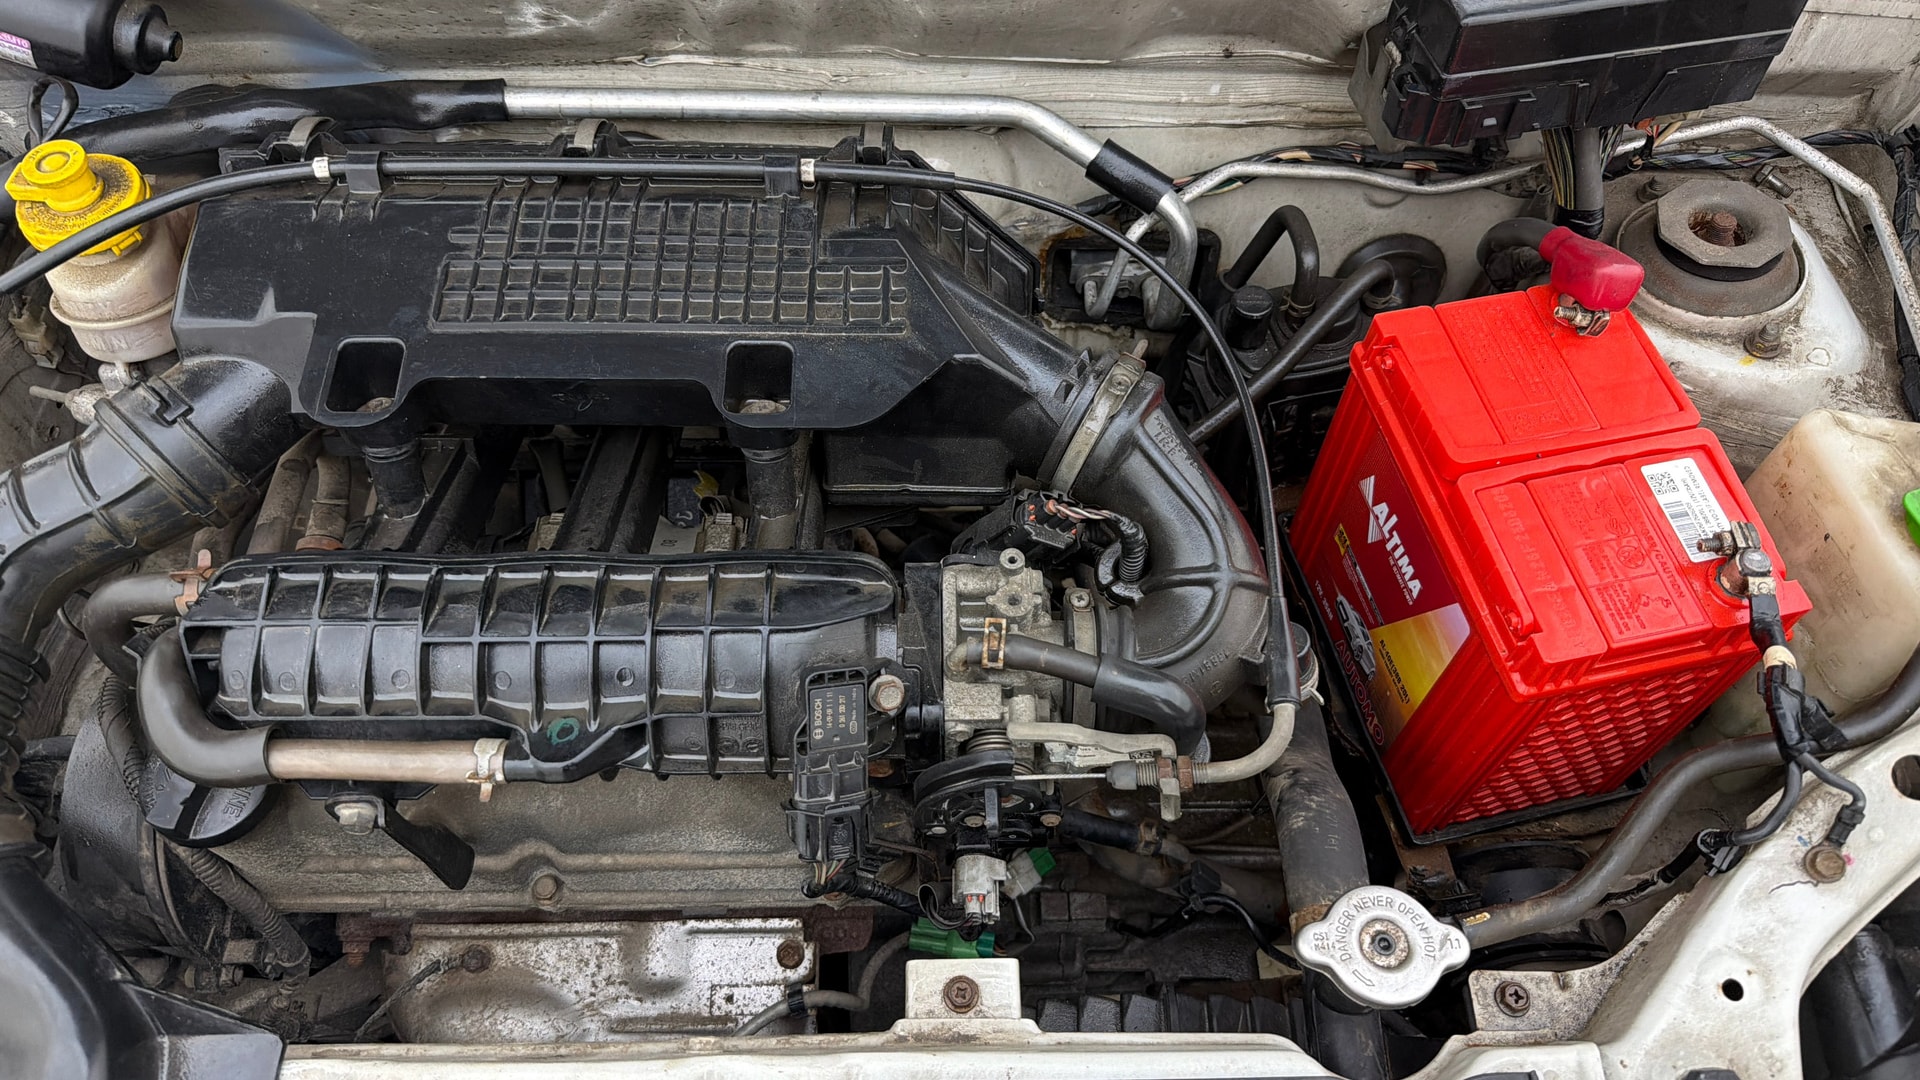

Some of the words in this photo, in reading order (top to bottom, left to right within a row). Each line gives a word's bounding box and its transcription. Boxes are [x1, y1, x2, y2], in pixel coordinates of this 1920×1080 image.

[1372, 502, 1423, 600] ALTIMA
[1390, 565, 1405, 588] ULTIMATE
[1401, 587, 1413, 605] POWER
[814, 698, 822, 726] BOSCH
[1336, 640, 1384, 746] AUTOMO
[1335, 910, 1355, 962] DANGER
[1352, 895, 1394, 913] NEVER
